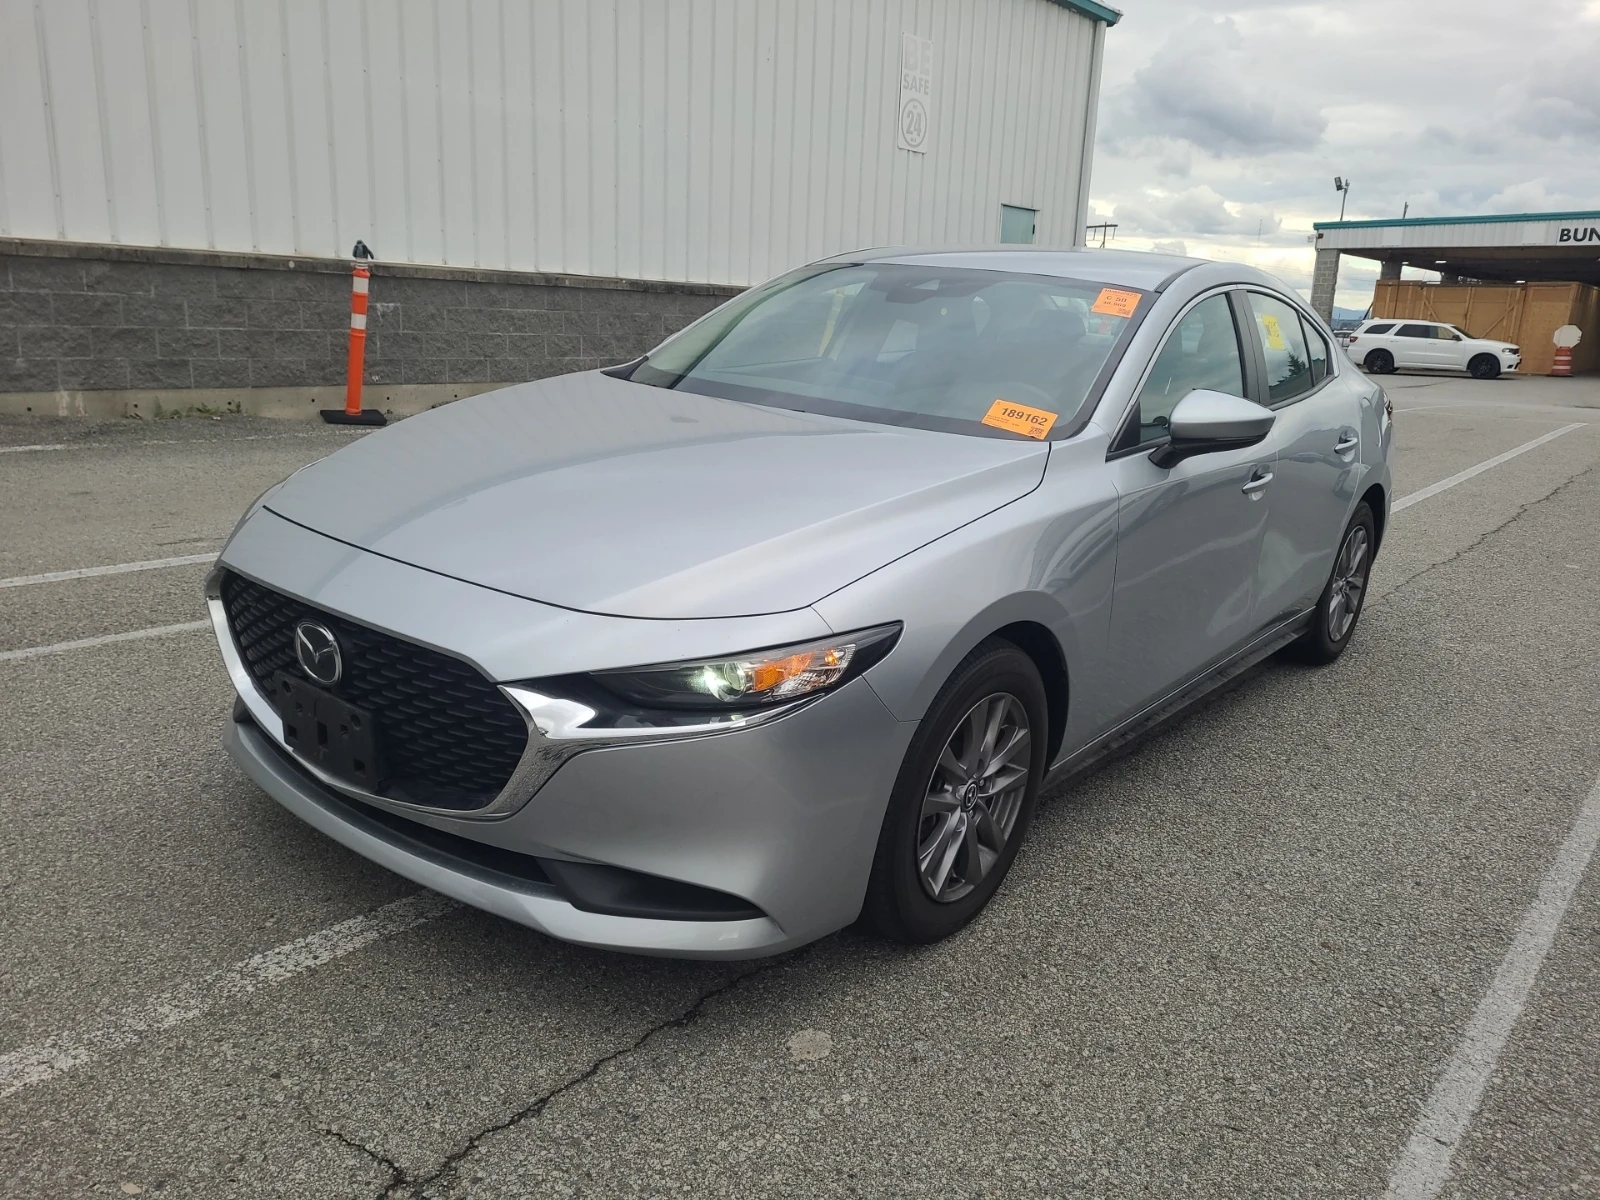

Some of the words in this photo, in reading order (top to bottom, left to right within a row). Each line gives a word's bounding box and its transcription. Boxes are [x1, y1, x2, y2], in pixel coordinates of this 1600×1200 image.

[904, 35, 931, 76] BE
[903, 73, 930, 95] SAFE
[906, 110, 922, 137] 24
[1559, 227, 1600, 242] BUN
[1002, 407, 1048, 427] 189162
